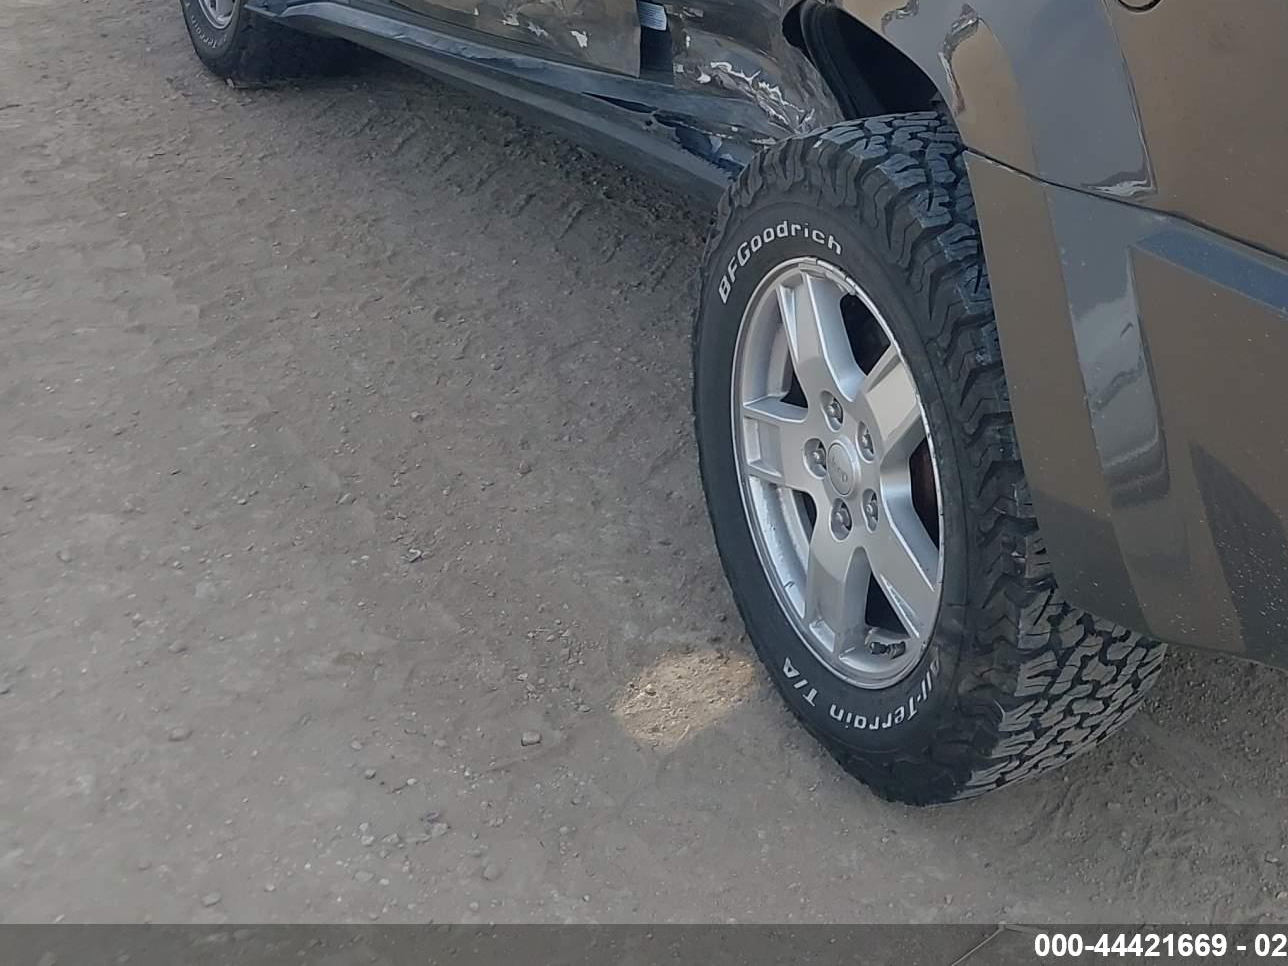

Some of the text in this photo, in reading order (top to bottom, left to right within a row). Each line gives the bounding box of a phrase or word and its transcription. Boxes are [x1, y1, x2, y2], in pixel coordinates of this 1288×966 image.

[718, 220, 842, 304] BFGoodrich
[783, 646, 940, 730] All-Terrain T/A
